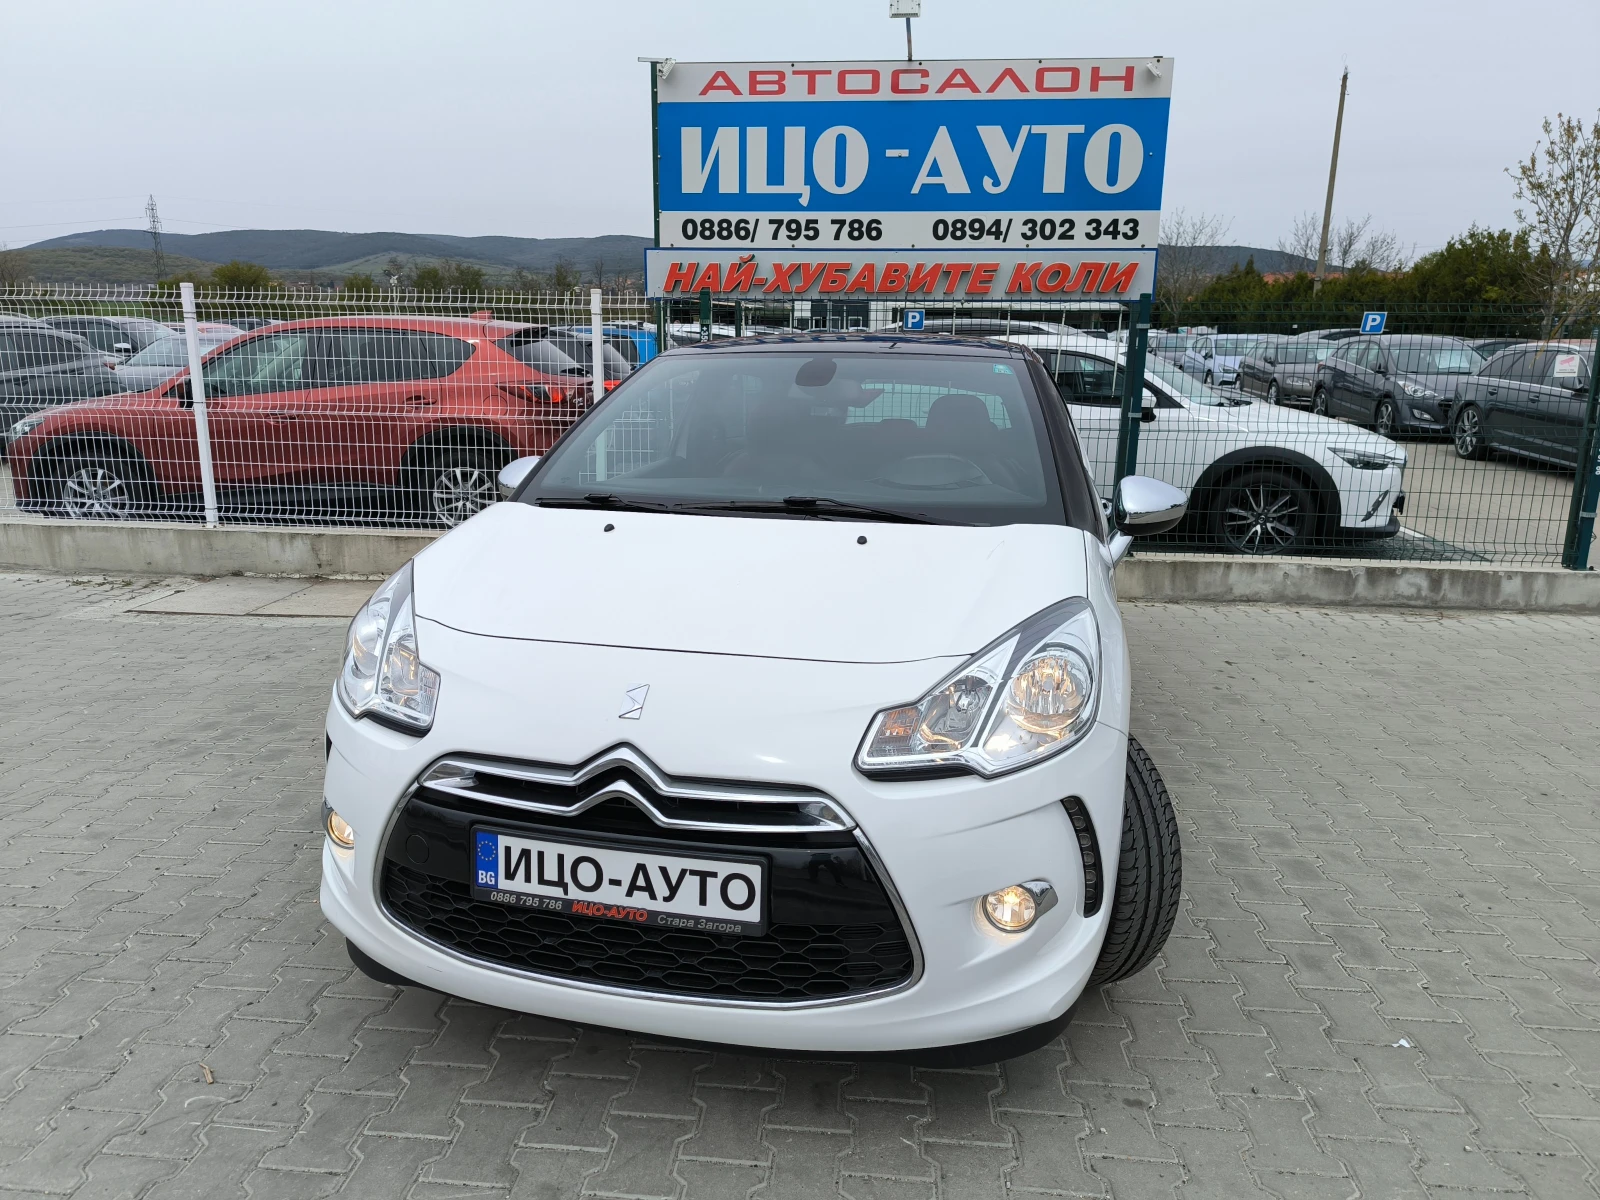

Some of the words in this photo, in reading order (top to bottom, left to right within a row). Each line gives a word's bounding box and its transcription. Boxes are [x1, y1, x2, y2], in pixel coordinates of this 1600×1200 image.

[698, 66, 1135, 96] АВТОСАЛОН
[681, 217, 760, 243] 0886/
[770, 218, 820, 241] 795
[829, 218, 883, 241] 786
[932, 217, 1013, 243] 0894/
[1020, 218, 1076, 241] 302
[1085, 218, 1140, 241] 343
[663, 254, 1001, 294] НАЙ-ХУБАВИТЕ
[1006, 261, 1141, 294] КОЛИ
[907, 311, 921, 328] P
[1365, 314, 1381, 332] P
[478, 869, 496, 885] BG
[504, 845, 757, 911] ИЦО-АУТО
[490, 891, 517, 904] 0886
[519, 895, 540, 907] 795
[542, 898, 563, 910] 786
[571, 901, 648, 922] ИЦО-АУТО
[657, 914, 695, 929] Стара
[697, 919, 742, 934] Загора
